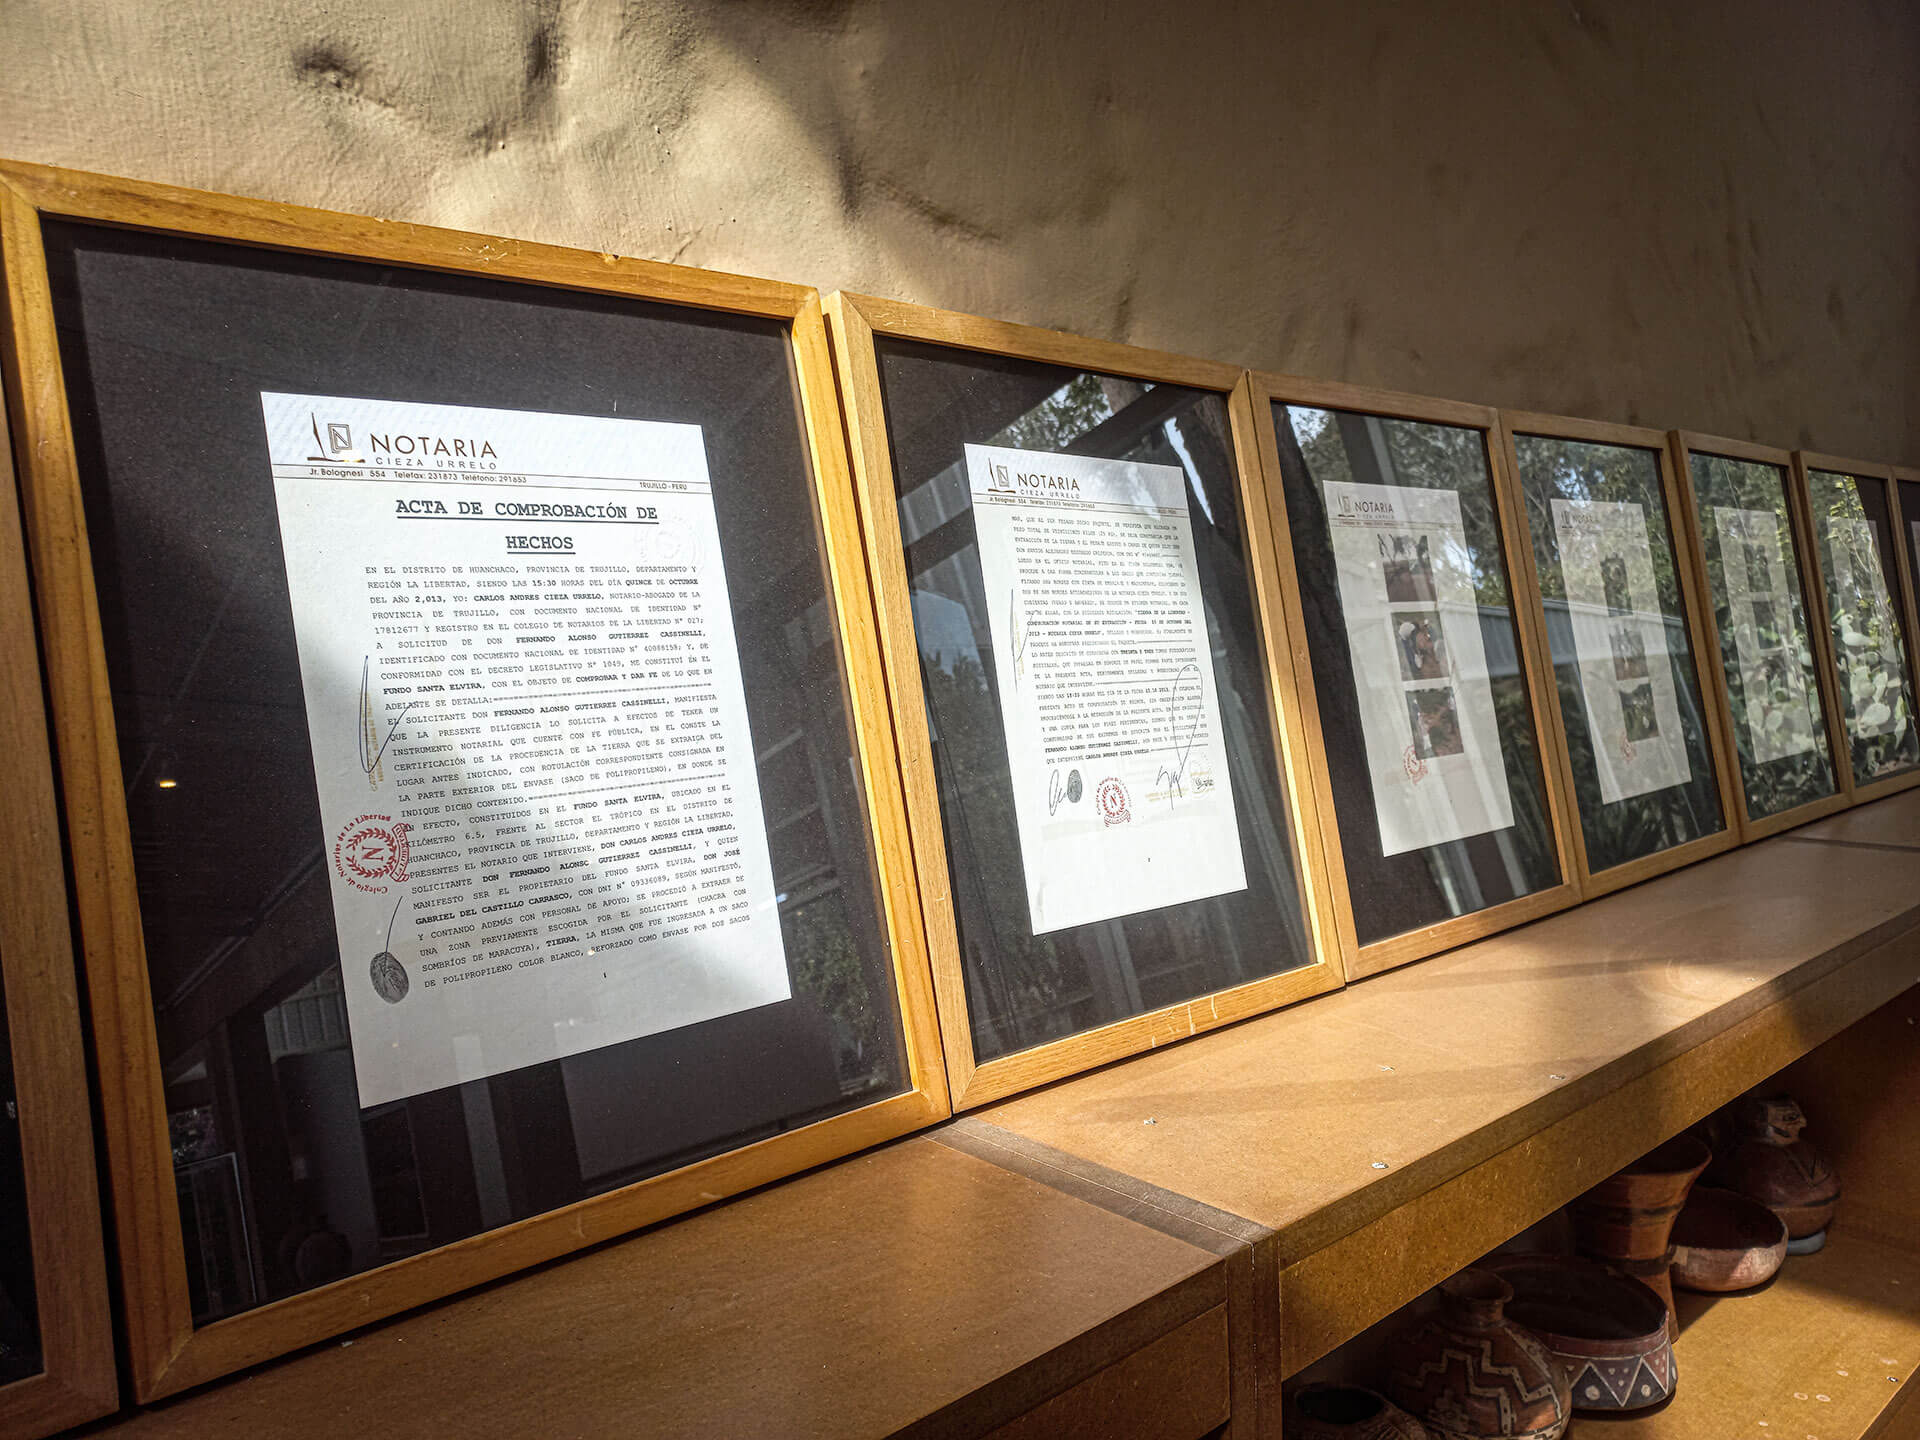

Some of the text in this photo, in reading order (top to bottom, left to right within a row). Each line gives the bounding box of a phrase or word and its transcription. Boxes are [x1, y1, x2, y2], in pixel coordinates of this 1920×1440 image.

[370, 434, 497, 457] NOTARIA
[375, 456, 496, 470] CIEZA URRELO
[321, 467, 363, 477] Bolognesi
[394, 472, 426, 480] Telefax:
[428, 473, 458, 481] 231873
[1017, 473, 1080, 491] NOTARIA
[396, 499, 658, 519] ACTA DE COMPROBACIÓN DE
[1354, 501, 1394, 514] NOTARIA
[506, 536, 573, 550] HECHOS
[367, 579, 401, 588] REGIÓN
[392, 594, 409, 603] AÑO
[415, 595, 446, 604] 2,013,
[372, 611, 422, 619] PROVINCIA
[374, 625, 418, 634] 17812677
[436, 624, 478, 632] REGISTRO
[398, 639, 447, 648] SOLICITUD
[516, 635, 555, 643] FERNANDO
[379, 654, 445, 664] IDENTIFICADO
[473, 651, 519, 659] DOCUMENTO
[525, 649, 563, 657] NACIONAL
[380, 669, 442, 679] CONFORMIDAD
[448, 668, 464, 676] CON
[488, 665, 523, 674] DECRETO
[530, 662, 582, 671] LEGISLATIVO
[383, 686, 411, 694] FUNDO
[417, 684, 444, 692] SANTA
[492, 680, 507, 688] CON
[527, 677, 557, 686] OBJETO
[576, 674, 618, 682] COMPROBAR
[406, 701, 616, 723] SOLICITANTE DON FERNANDO ALONSO GUTIERREZ
[435, 699, 446, 707] SE
[417, 730, 428, 738] LA
[438, 726, 480, 736] PRESENTE
[491, 721, 541, 732] DILIGENCIA
[392, 734, 562, 756] INSTRUMENTO NOTARIAL QUE CUENTE
[394, 748, 564, 771] CERTIFICACIÓN DE LA PROCEDENCIA
[396, 758, 589, 786] LUGAR ANTES CON ROTULACIÓN
[398, 778, 553, 802] LA PARTE EXTERIOR DEL ENVASE
[401, 802, 472, 817] INDIQUE DICHO
[469, 809, 531, 824] CONSTITUIDOS
[539, 807, 549, 815] EN
[574, 801, 598, 810] FUNDO
[496, 817, 583, 835] FRENTE AL SECTOR
[468, 839, 531, 854] PROVINCIA DE
[410, 841, 615, 879] PRESENTES EL NOTARIO QUE DON
[412, 851, 640, 894] SOLICITANTE DON FERNANDO GUTIERREZ
[413, 872, 597, 909] MANIFESTO SER EL PROPIETARIO DEL
[415, 887, 593, 924] GABRIEL DEL CASTILLO CON
[430, 902, 597, 938] CONTANDO ADEMÁS CON PERSONAL DE
[419, 918, 588, 955] UNA ZONA PREVIAMENTE ESCOGIDA
[422, 930, 596, 971] SOMBRÍOS DE LA
[424, 956, 544, 987] DE POLIPROPILENO COLOR
